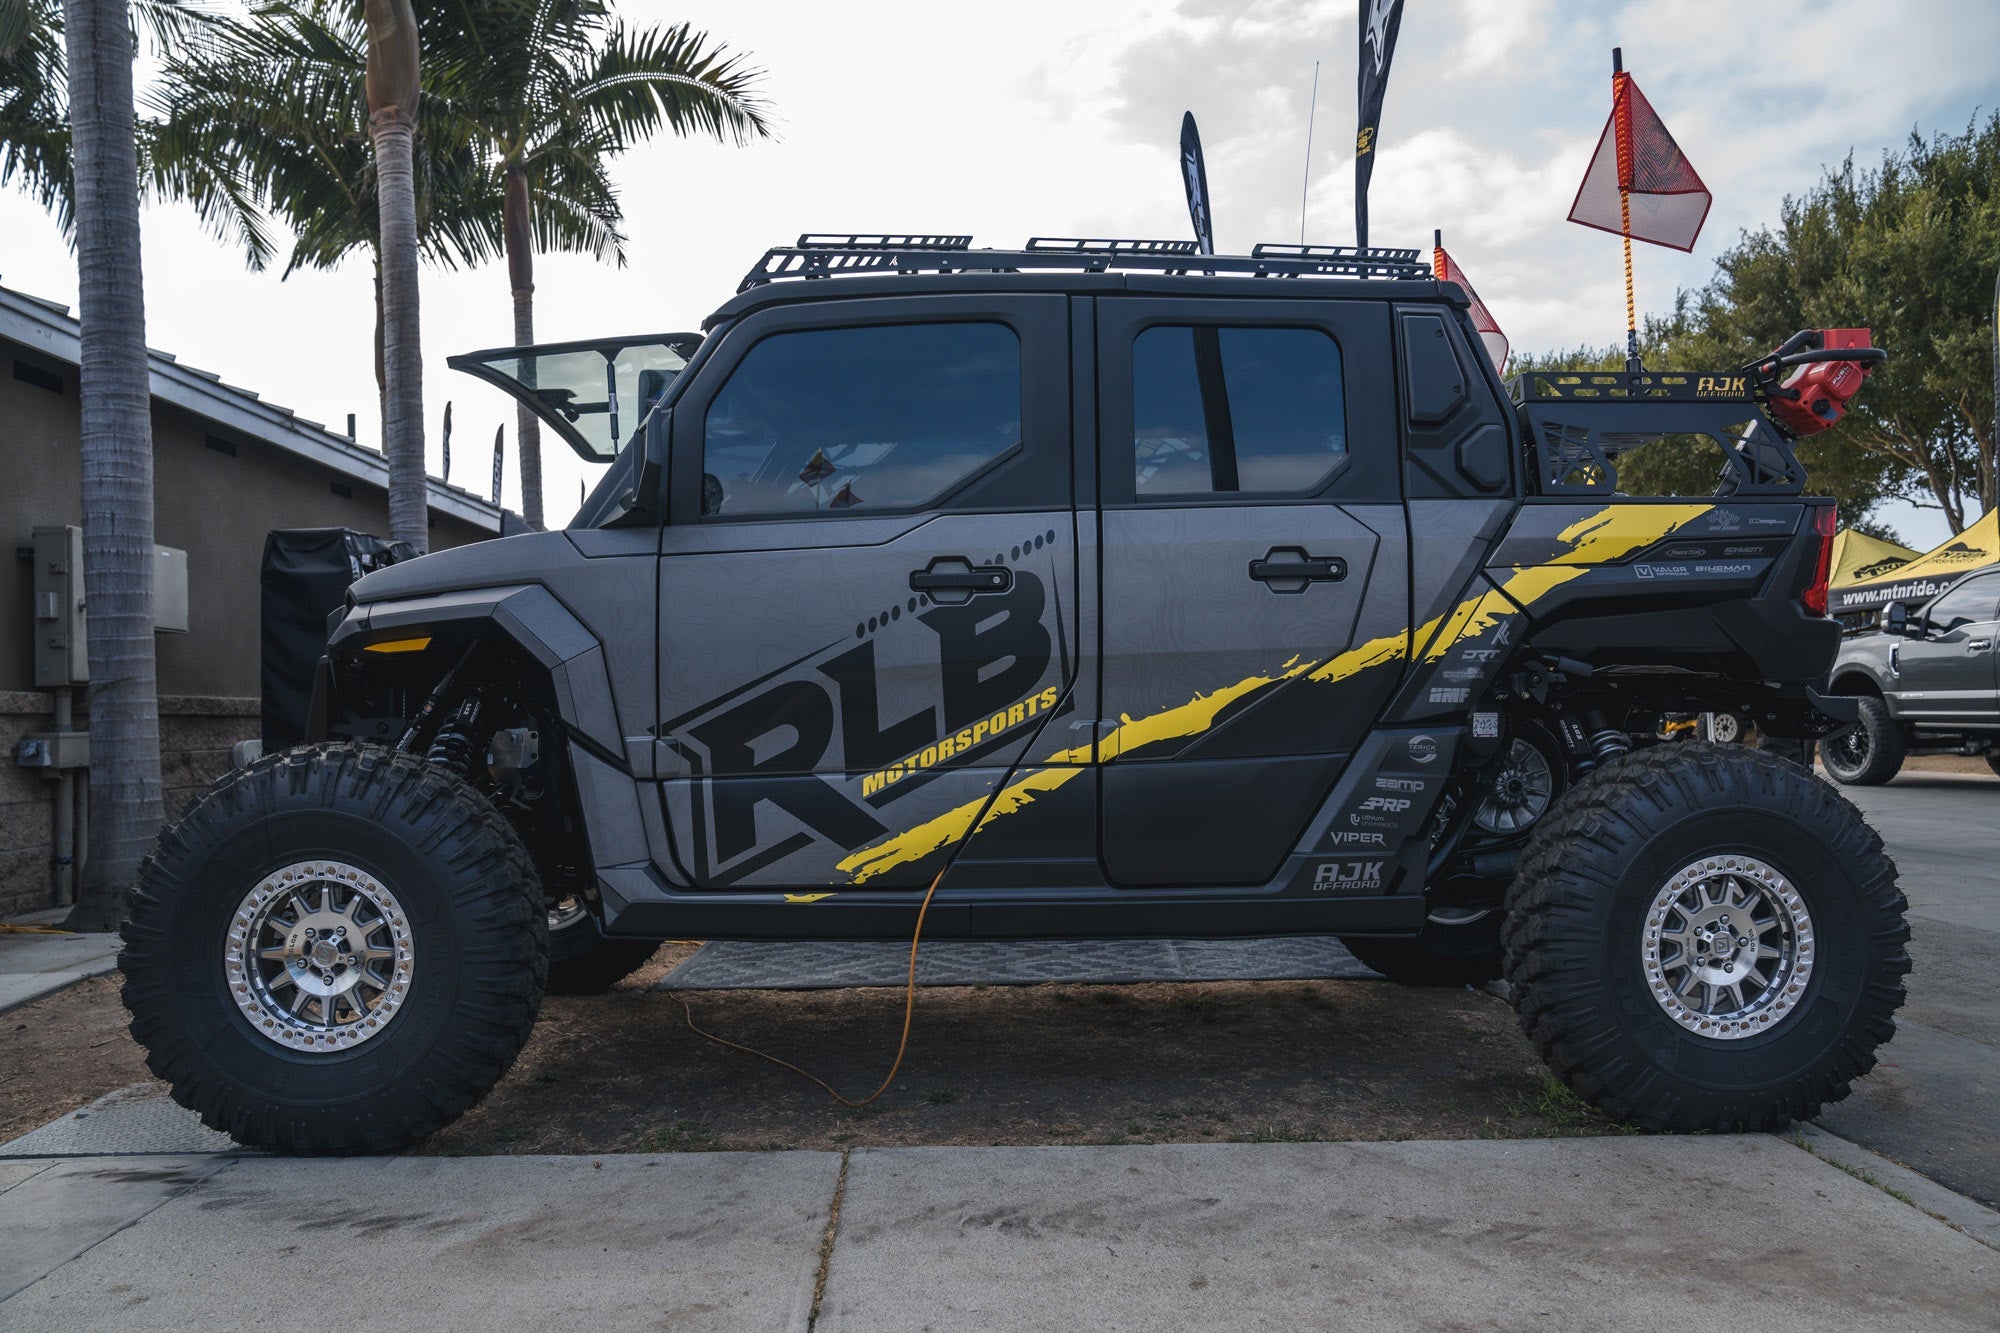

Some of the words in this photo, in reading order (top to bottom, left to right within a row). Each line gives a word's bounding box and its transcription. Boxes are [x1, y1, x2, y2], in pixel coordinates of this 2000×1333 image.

[1697, 377, 1746, 391] AJK
[1462, 649, 1501, 662] DRT
[1428, 687, 1471, 703] HMF
[687, 570, 1052, 866] RLB
[862, 686, 1057, 798] MOTORSPORTS
[1358, 797, 1412, 812] PRP
[1330, 831, 1387, 847] VIPER
[1314, 861, 1385, 882] AJK
[1312, 880, 1381, 891] OFFROAD
